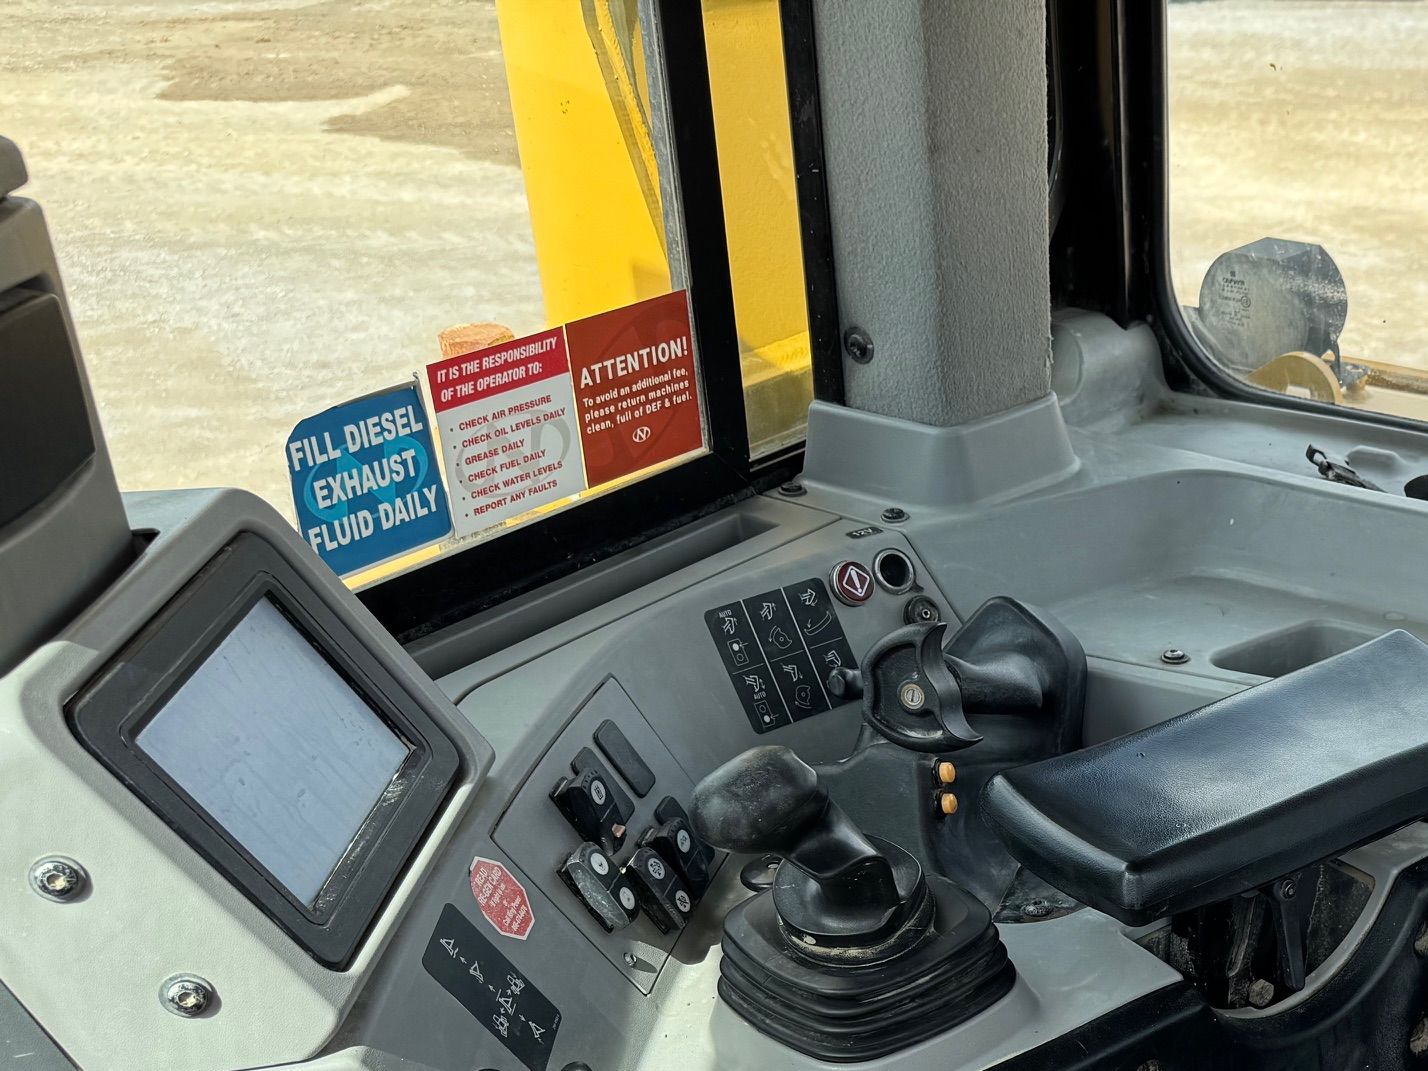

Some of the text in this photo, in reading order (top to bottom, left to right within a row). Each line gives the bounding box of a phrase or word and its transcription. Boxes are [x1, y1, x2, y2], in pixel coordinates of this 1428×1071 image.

[437, 337, 557, 383] IT IS THE RESPONSIBILITY
[580, 336, 688, 389] ATTENTION!
[441, 362, 542, 403] OF THE OPERATOR TO:
[583, 368, 688, 408] To avoid an additional fee,
[585, 380, 689, 423] please return machines
[459, 395, 552, 431] CHECK AIR PRESSURE
[462, 407, 566, 448] CHECK OIL LEVELS DAILY
[587, 391, 692, 434] clean, full of DEF & fuel.
[289, 405, 424, 472] FILL DIESEL
[465, 439, 525, 465] GREASE DAILY
[313, 449, 416, 510] EXHAUST
[468, 449, 546, 482] CHECK FUEL DAILY
[471, 461, 563, 499] CHECK WATER LEVELS
[473, 480, 557, 516] REPORT ANY FAULTS
[308, 484, 437, 555] FLUID DAILY
[489, 866, 502, 885] CARD
